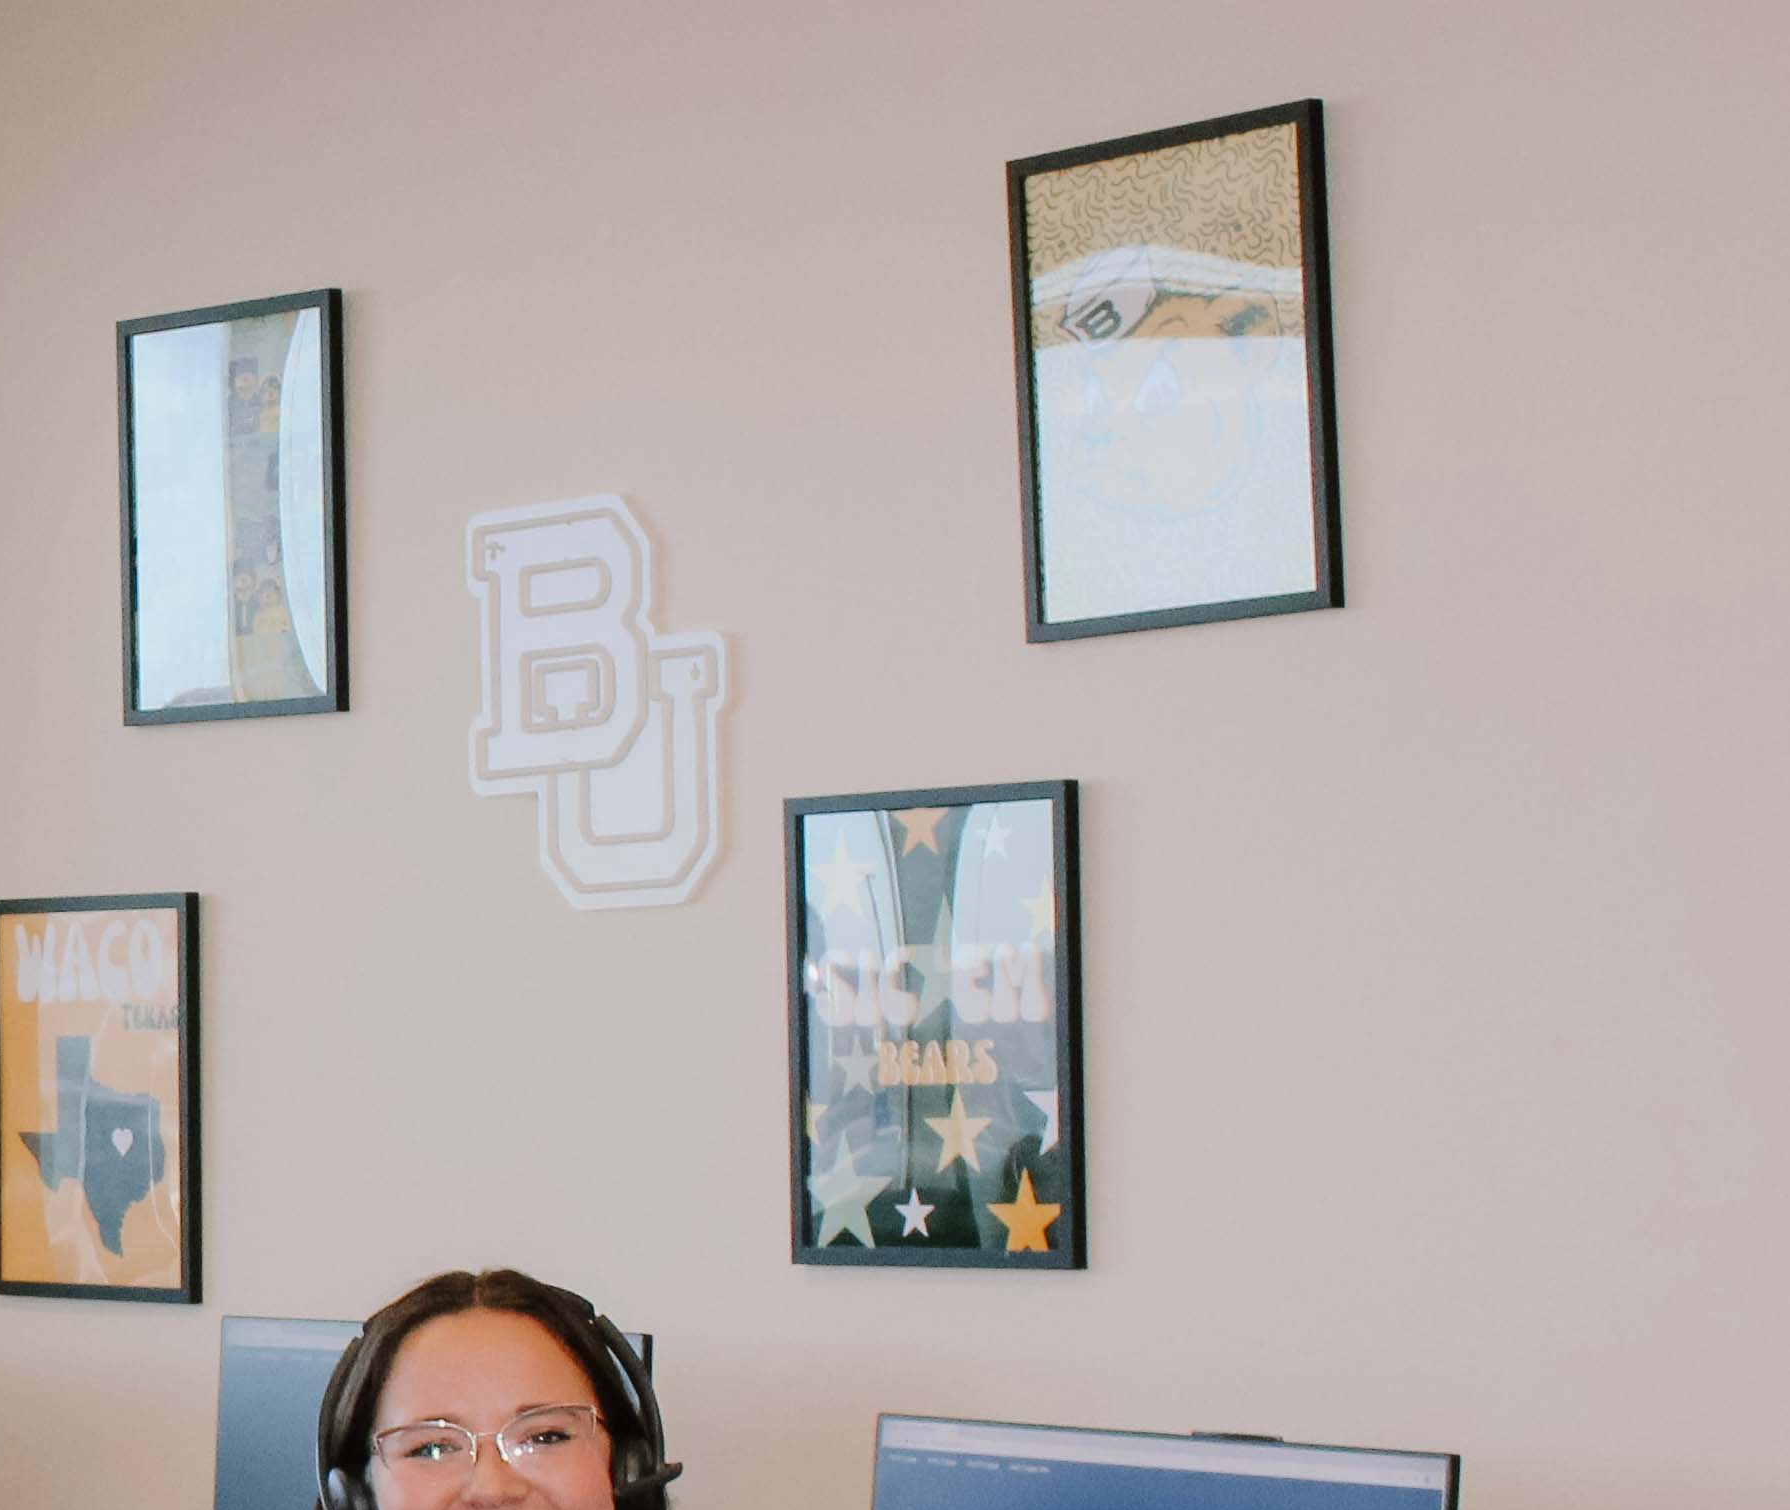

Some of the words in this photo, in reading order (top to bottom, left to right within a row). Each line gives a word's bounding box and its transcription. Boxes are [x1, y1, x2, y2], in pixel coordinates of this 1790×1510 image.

[466, 493, 726, 910] BU
[15, 917, 164, 1004] WACO
[876, 1039, 999, 1086] BEARS
